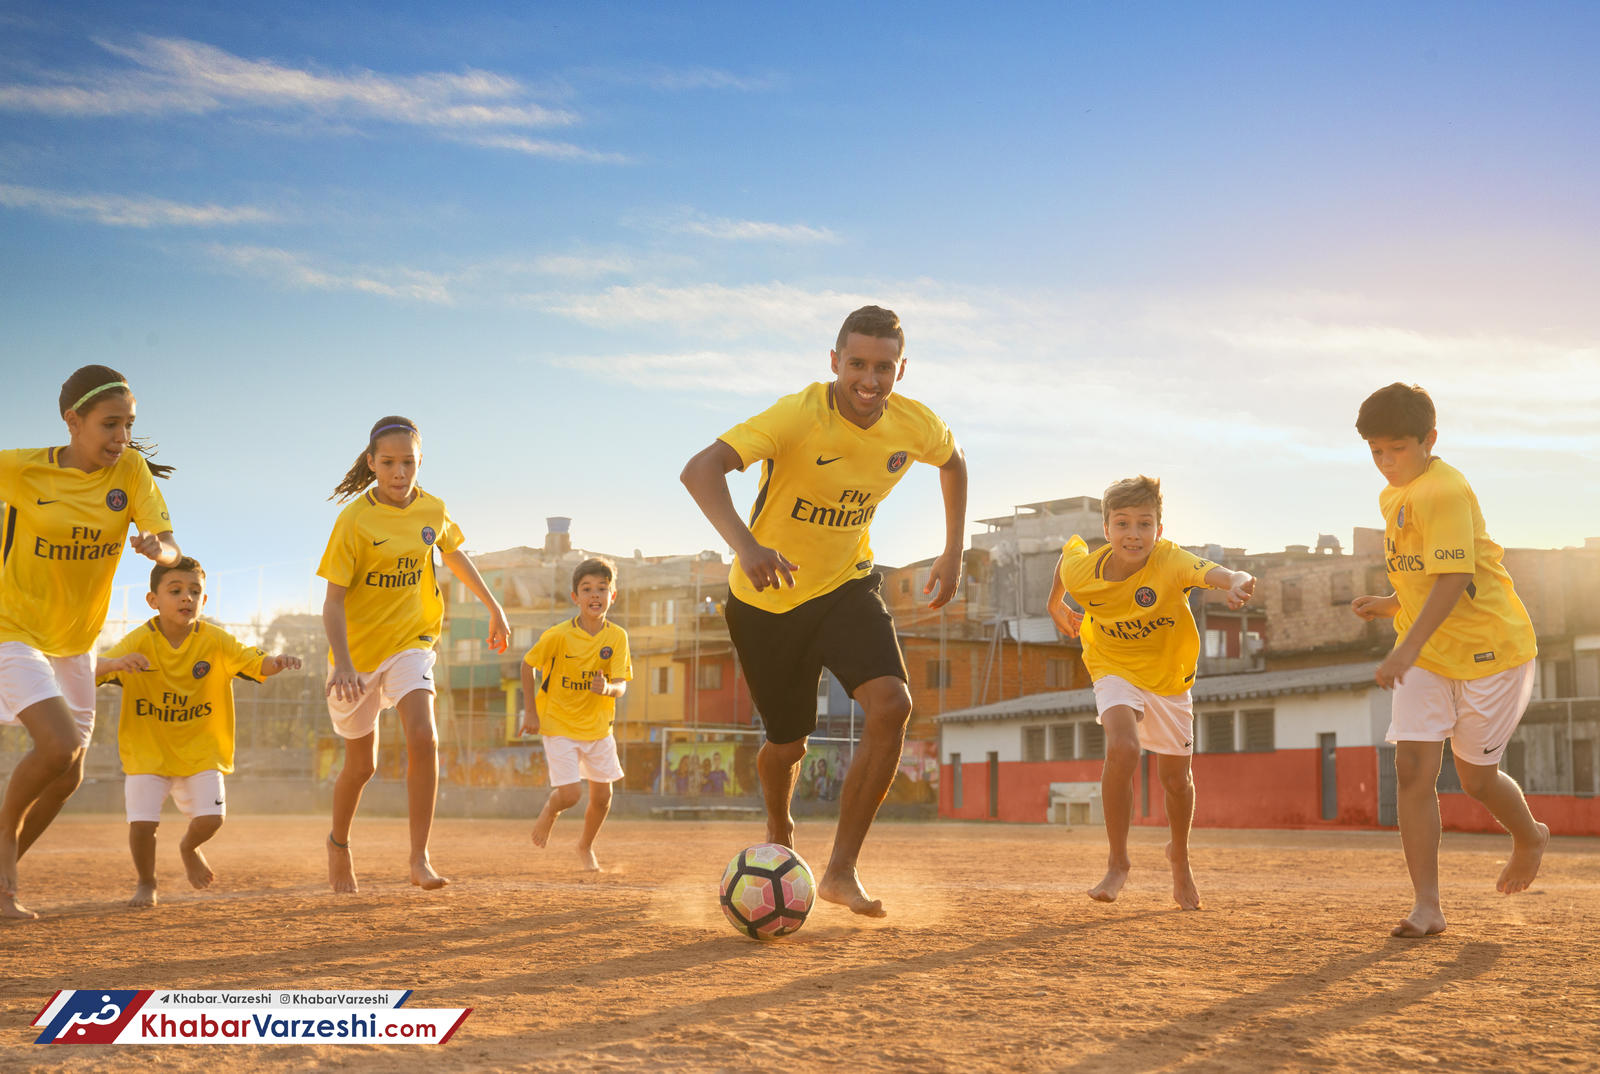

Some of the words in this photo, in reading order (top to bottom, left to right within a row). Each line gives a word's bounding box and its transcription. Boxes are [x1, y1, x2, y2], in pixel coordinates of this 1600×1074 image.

[838, 489, 872, 507] Fly
[790, 496, 878, 527] Emirat
[71, 526, 102, 542] Fly
[1386, 553, 1425, 574] rates
[1434, 549, 1466, 560] QNB
[365, 568, 423, 588] Emirat
[162, 691, 188, 707] Fly
[135, 697, 212, 723] Emirates
